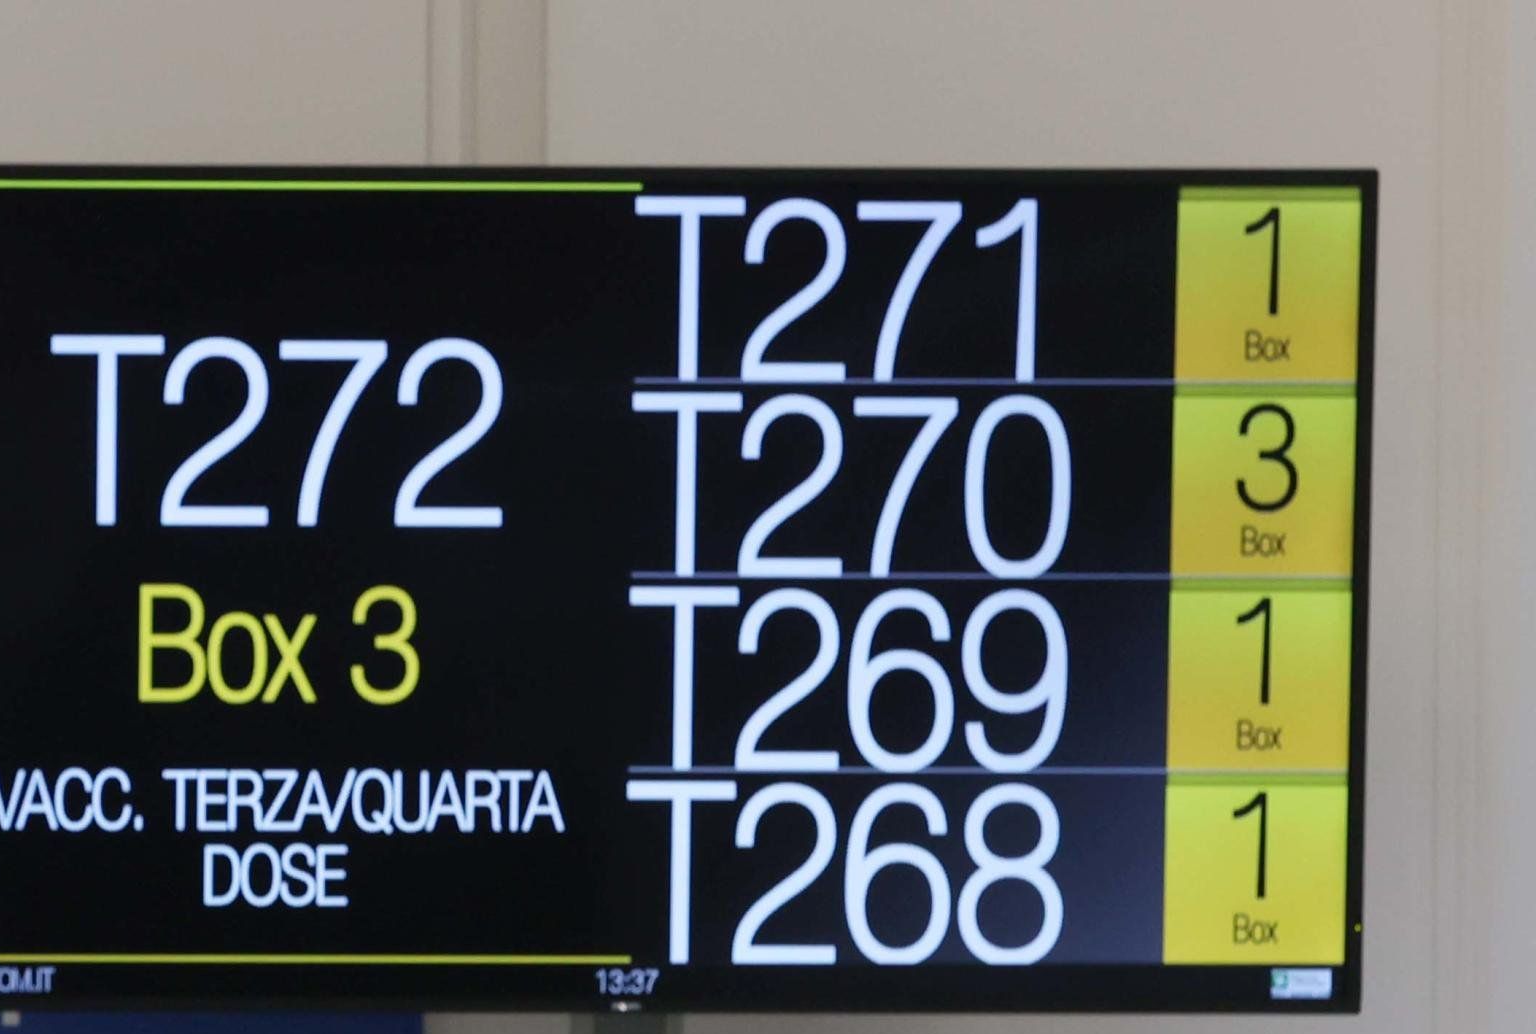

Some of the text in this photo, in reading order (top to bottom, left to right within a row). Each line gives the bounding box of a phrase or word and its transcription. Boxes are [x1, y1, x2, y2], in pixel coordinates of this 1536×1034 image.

[633, 194, 1040, 384] T271
[1243, 206, 1282, 317] 1
[1243, 329, 1292, 363] Box
[49, 333, 504, 529] T272
[630, 391, 1073, 580] T270
[1235, 402, 1299, 514] 3
[1239, 524, 1288, 559] Box
[137, 582, 421, 706] Box 3
[627, 585, 1070, 774] T269
[1235, 596, 1273, 706] 1
[1235, 719, 1283, 752] Box
[161, 767, 566, 835] TERZA/QUARTA
[1231, 791, 1268, 900] 1
[202, 842, 350, 908] DOSE
[625, 779, 1066, 966] T268
[594, 967, 661, 996] 13:37
[1231, 914, 1279, 946] Box
